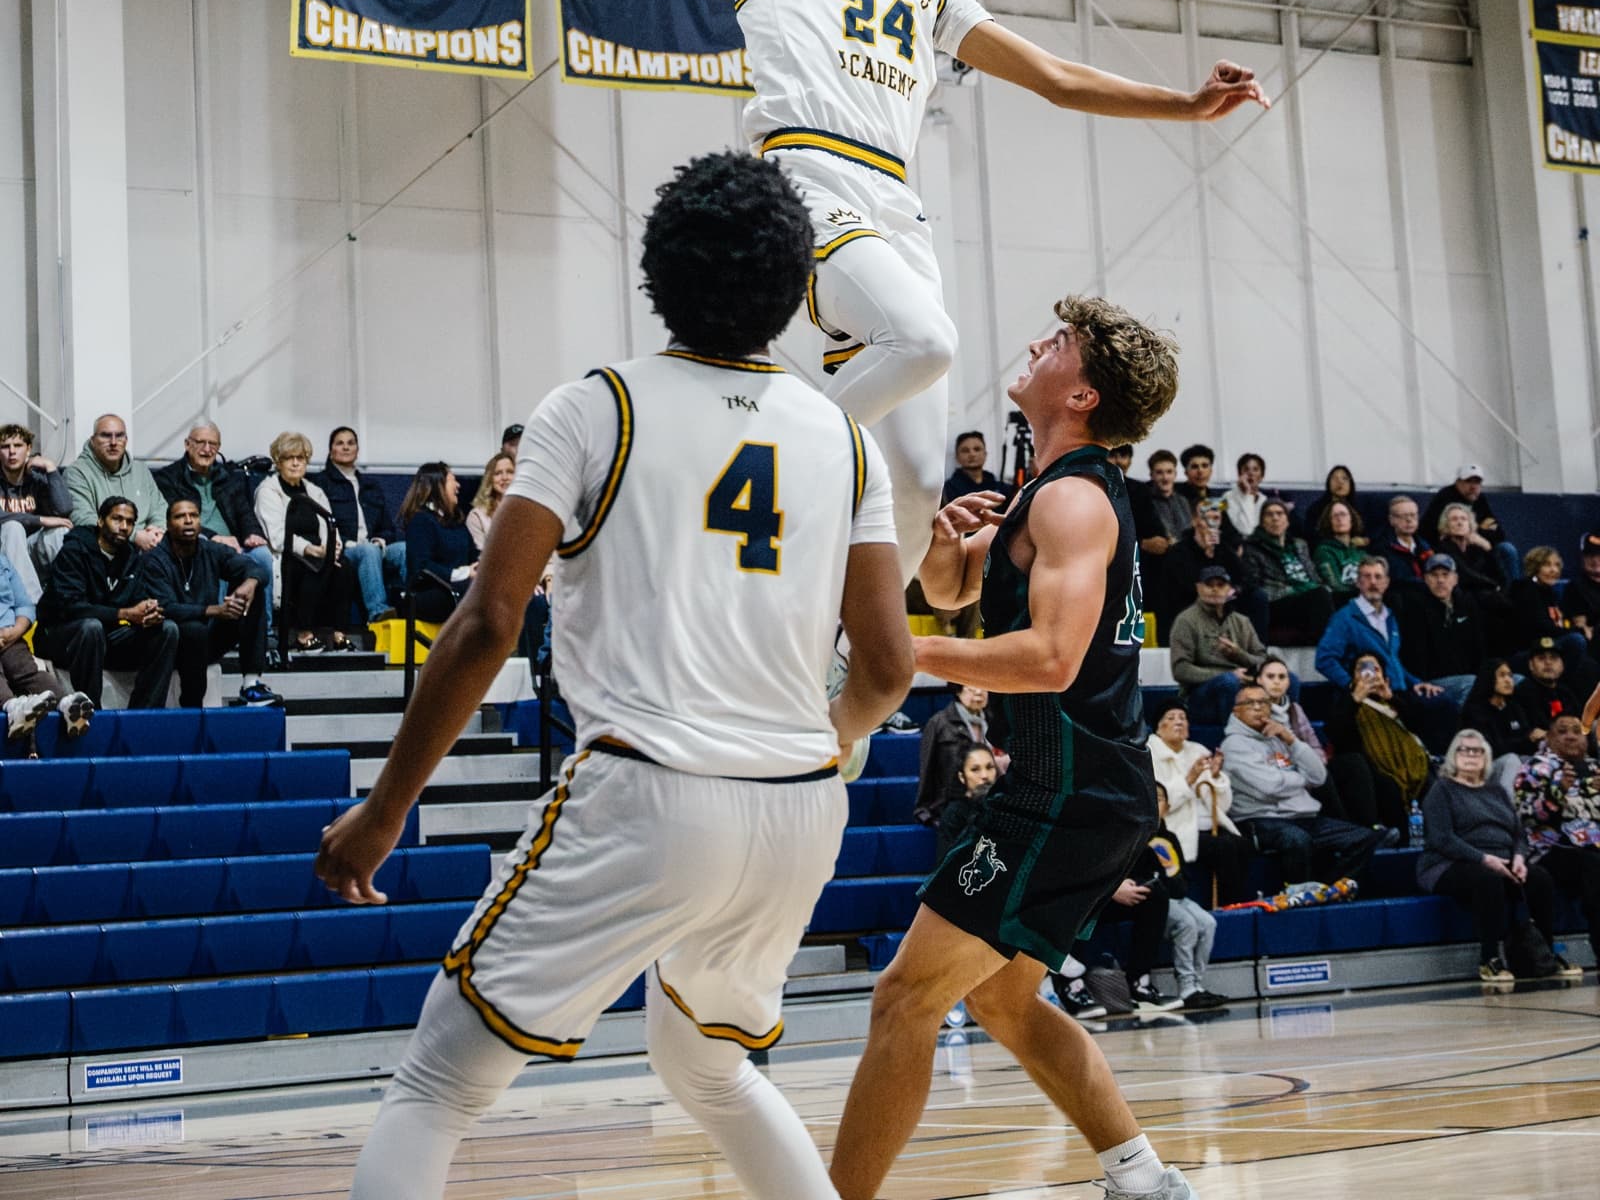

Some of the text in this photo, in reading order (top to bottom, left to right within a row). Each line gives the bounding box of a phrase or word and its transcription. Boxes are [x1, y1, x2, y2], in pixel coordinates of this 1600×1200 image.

[722, 395, 760, 412] TKA
[703, 440, 786, 576] 4
[87, 1062, 180, 1077] COMPANION SEAT WILL BE MADE
[95, 1071, 173, 1084] AVAILABLE UPON REQUEST
